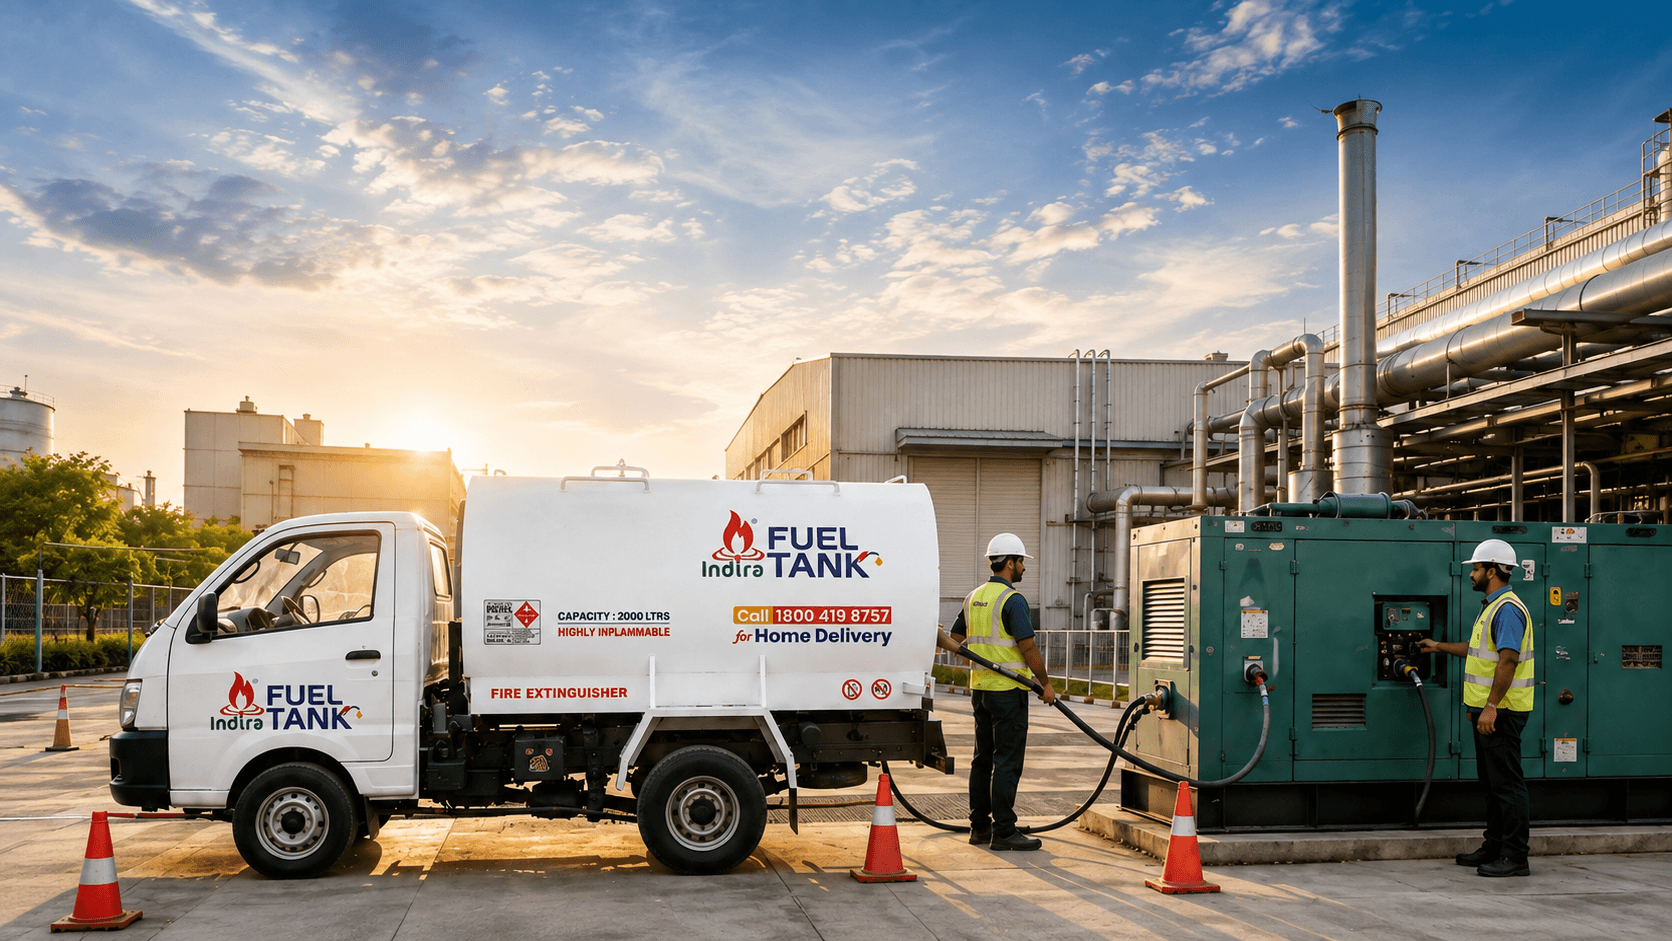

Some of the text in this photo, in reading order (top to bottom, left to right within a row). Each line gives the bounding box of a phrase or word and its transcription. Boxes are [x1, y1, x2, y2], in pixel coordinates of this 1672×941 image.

[768, 527, 859, 550] FUEL
[702, 553, 870, 578] Indira TANK
[557, 612, 610, 620] CAPACITY
[617, 612, 643, 621] 2000
[645, 612, 670, 621] LTRS
[737, 609, 890, 622] Call 1800 419 8757
[558, 627, 671, 637] HIGHLY INPLAMMABLE
[732, 628, 892, 647] for Home Delivery
[267, 685, 343, 706] FUEL
[491, 687, 628, 699] FIRE EXTINGUISHER
[210, 708, 352, 730] Indira TANK
